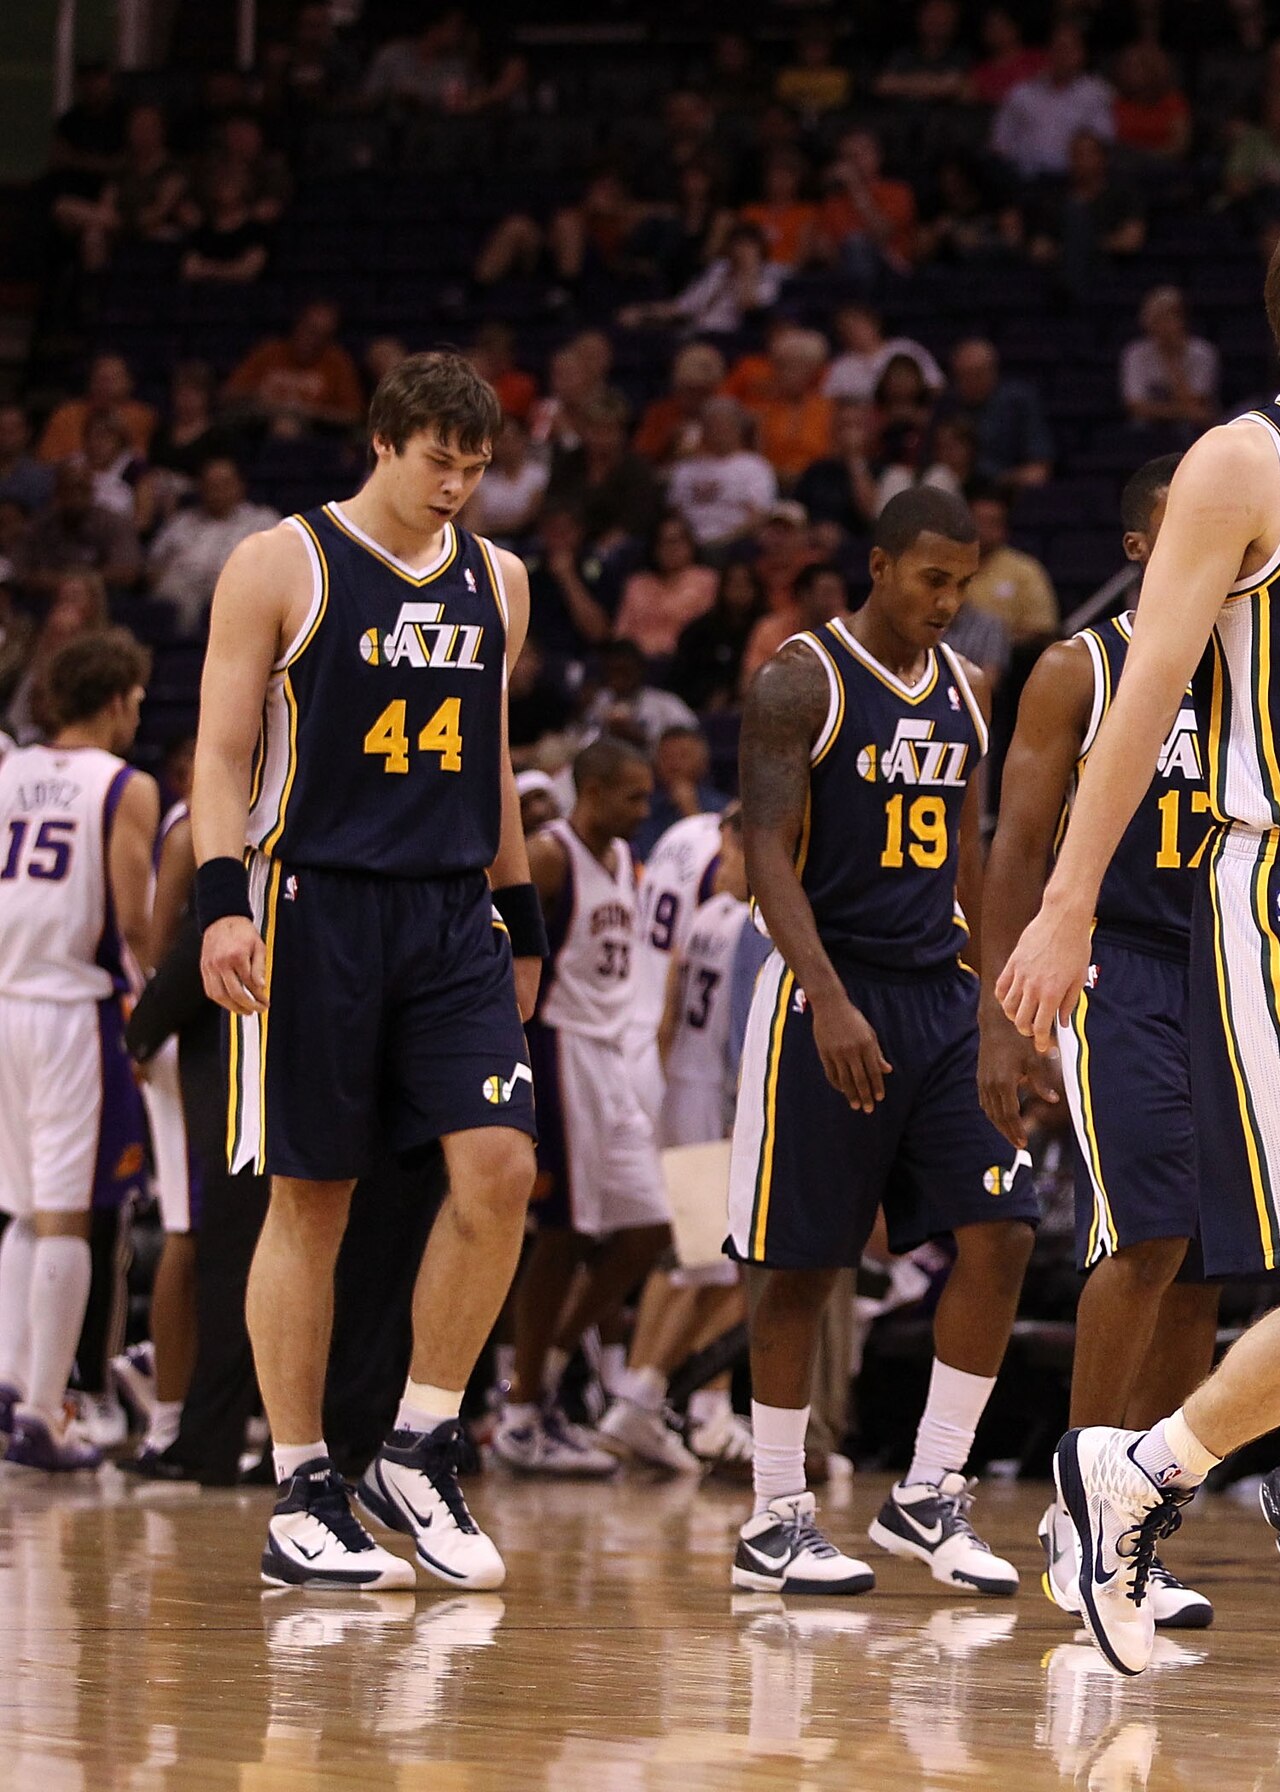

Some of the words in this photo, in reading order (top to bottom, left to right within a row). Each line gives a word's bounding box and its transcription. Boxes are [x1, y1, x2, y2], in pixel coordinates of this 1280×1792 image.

[383, 601, 486, 671] JAZZ
[363, 696, 463, 774] 44
[880, 717, 970, 788] JAZZ
[0, 820, 77, 881] 15
[880, 793, 949, 870] 19
